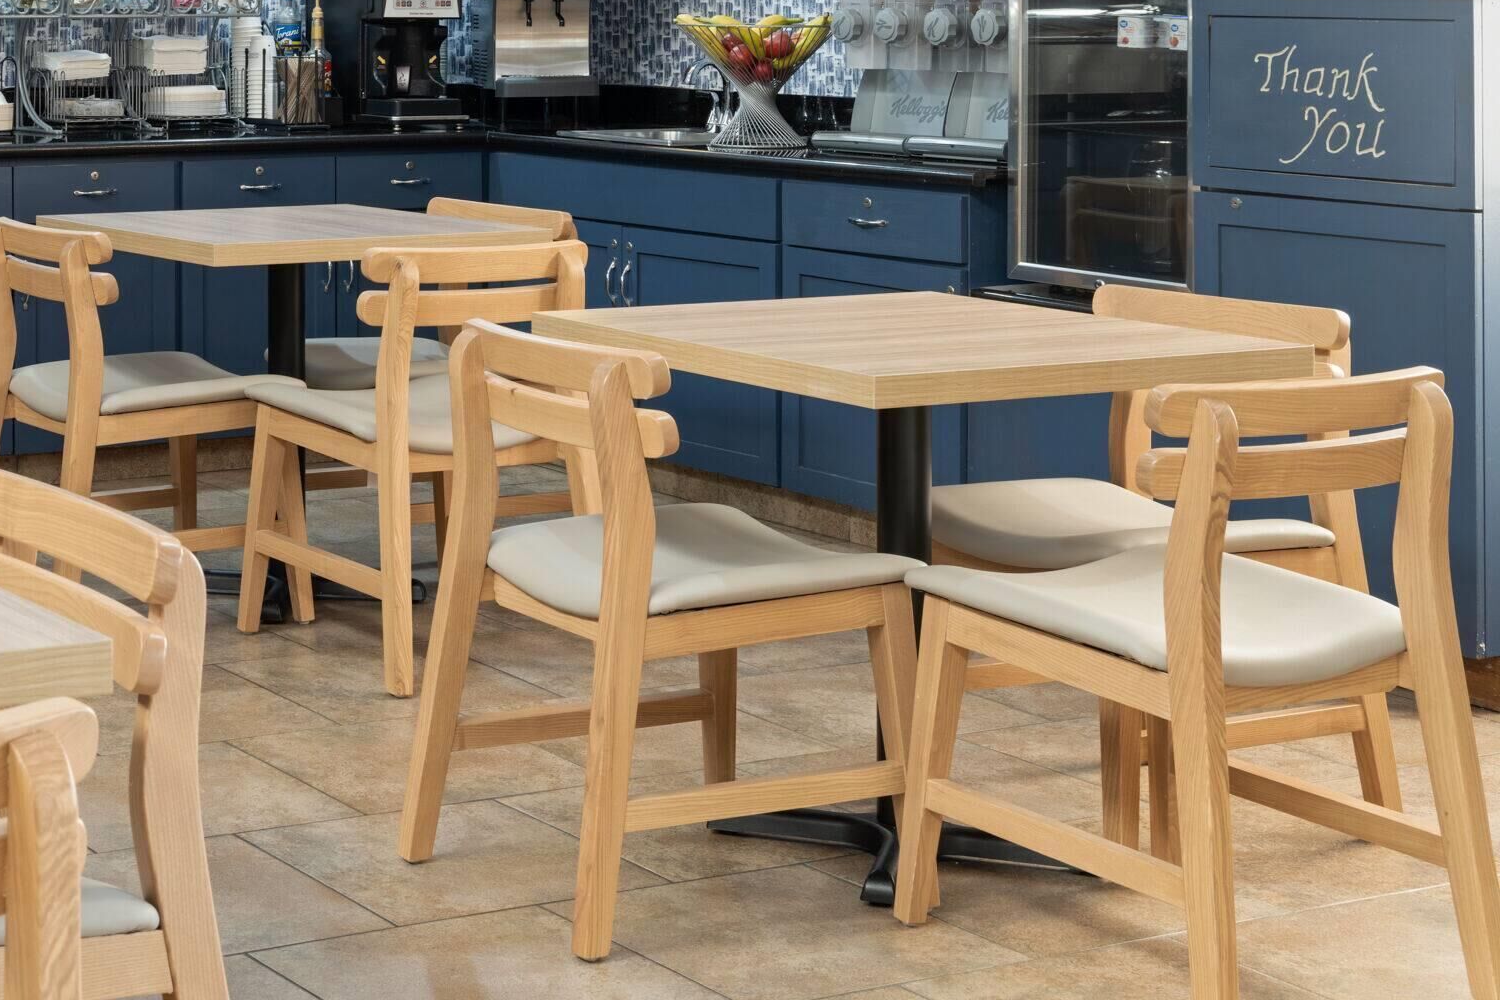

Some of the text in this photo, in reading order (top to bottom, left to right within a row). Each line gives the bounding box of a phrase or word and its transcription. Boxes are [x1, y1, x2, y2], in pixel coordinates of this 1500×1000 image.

[275, 26, 300, 42] Torani
[1254, 44, 1386, 112] Thank
[890, 94, 946, 123] Kellogg's
[1278, 105, 1386, 164] You
